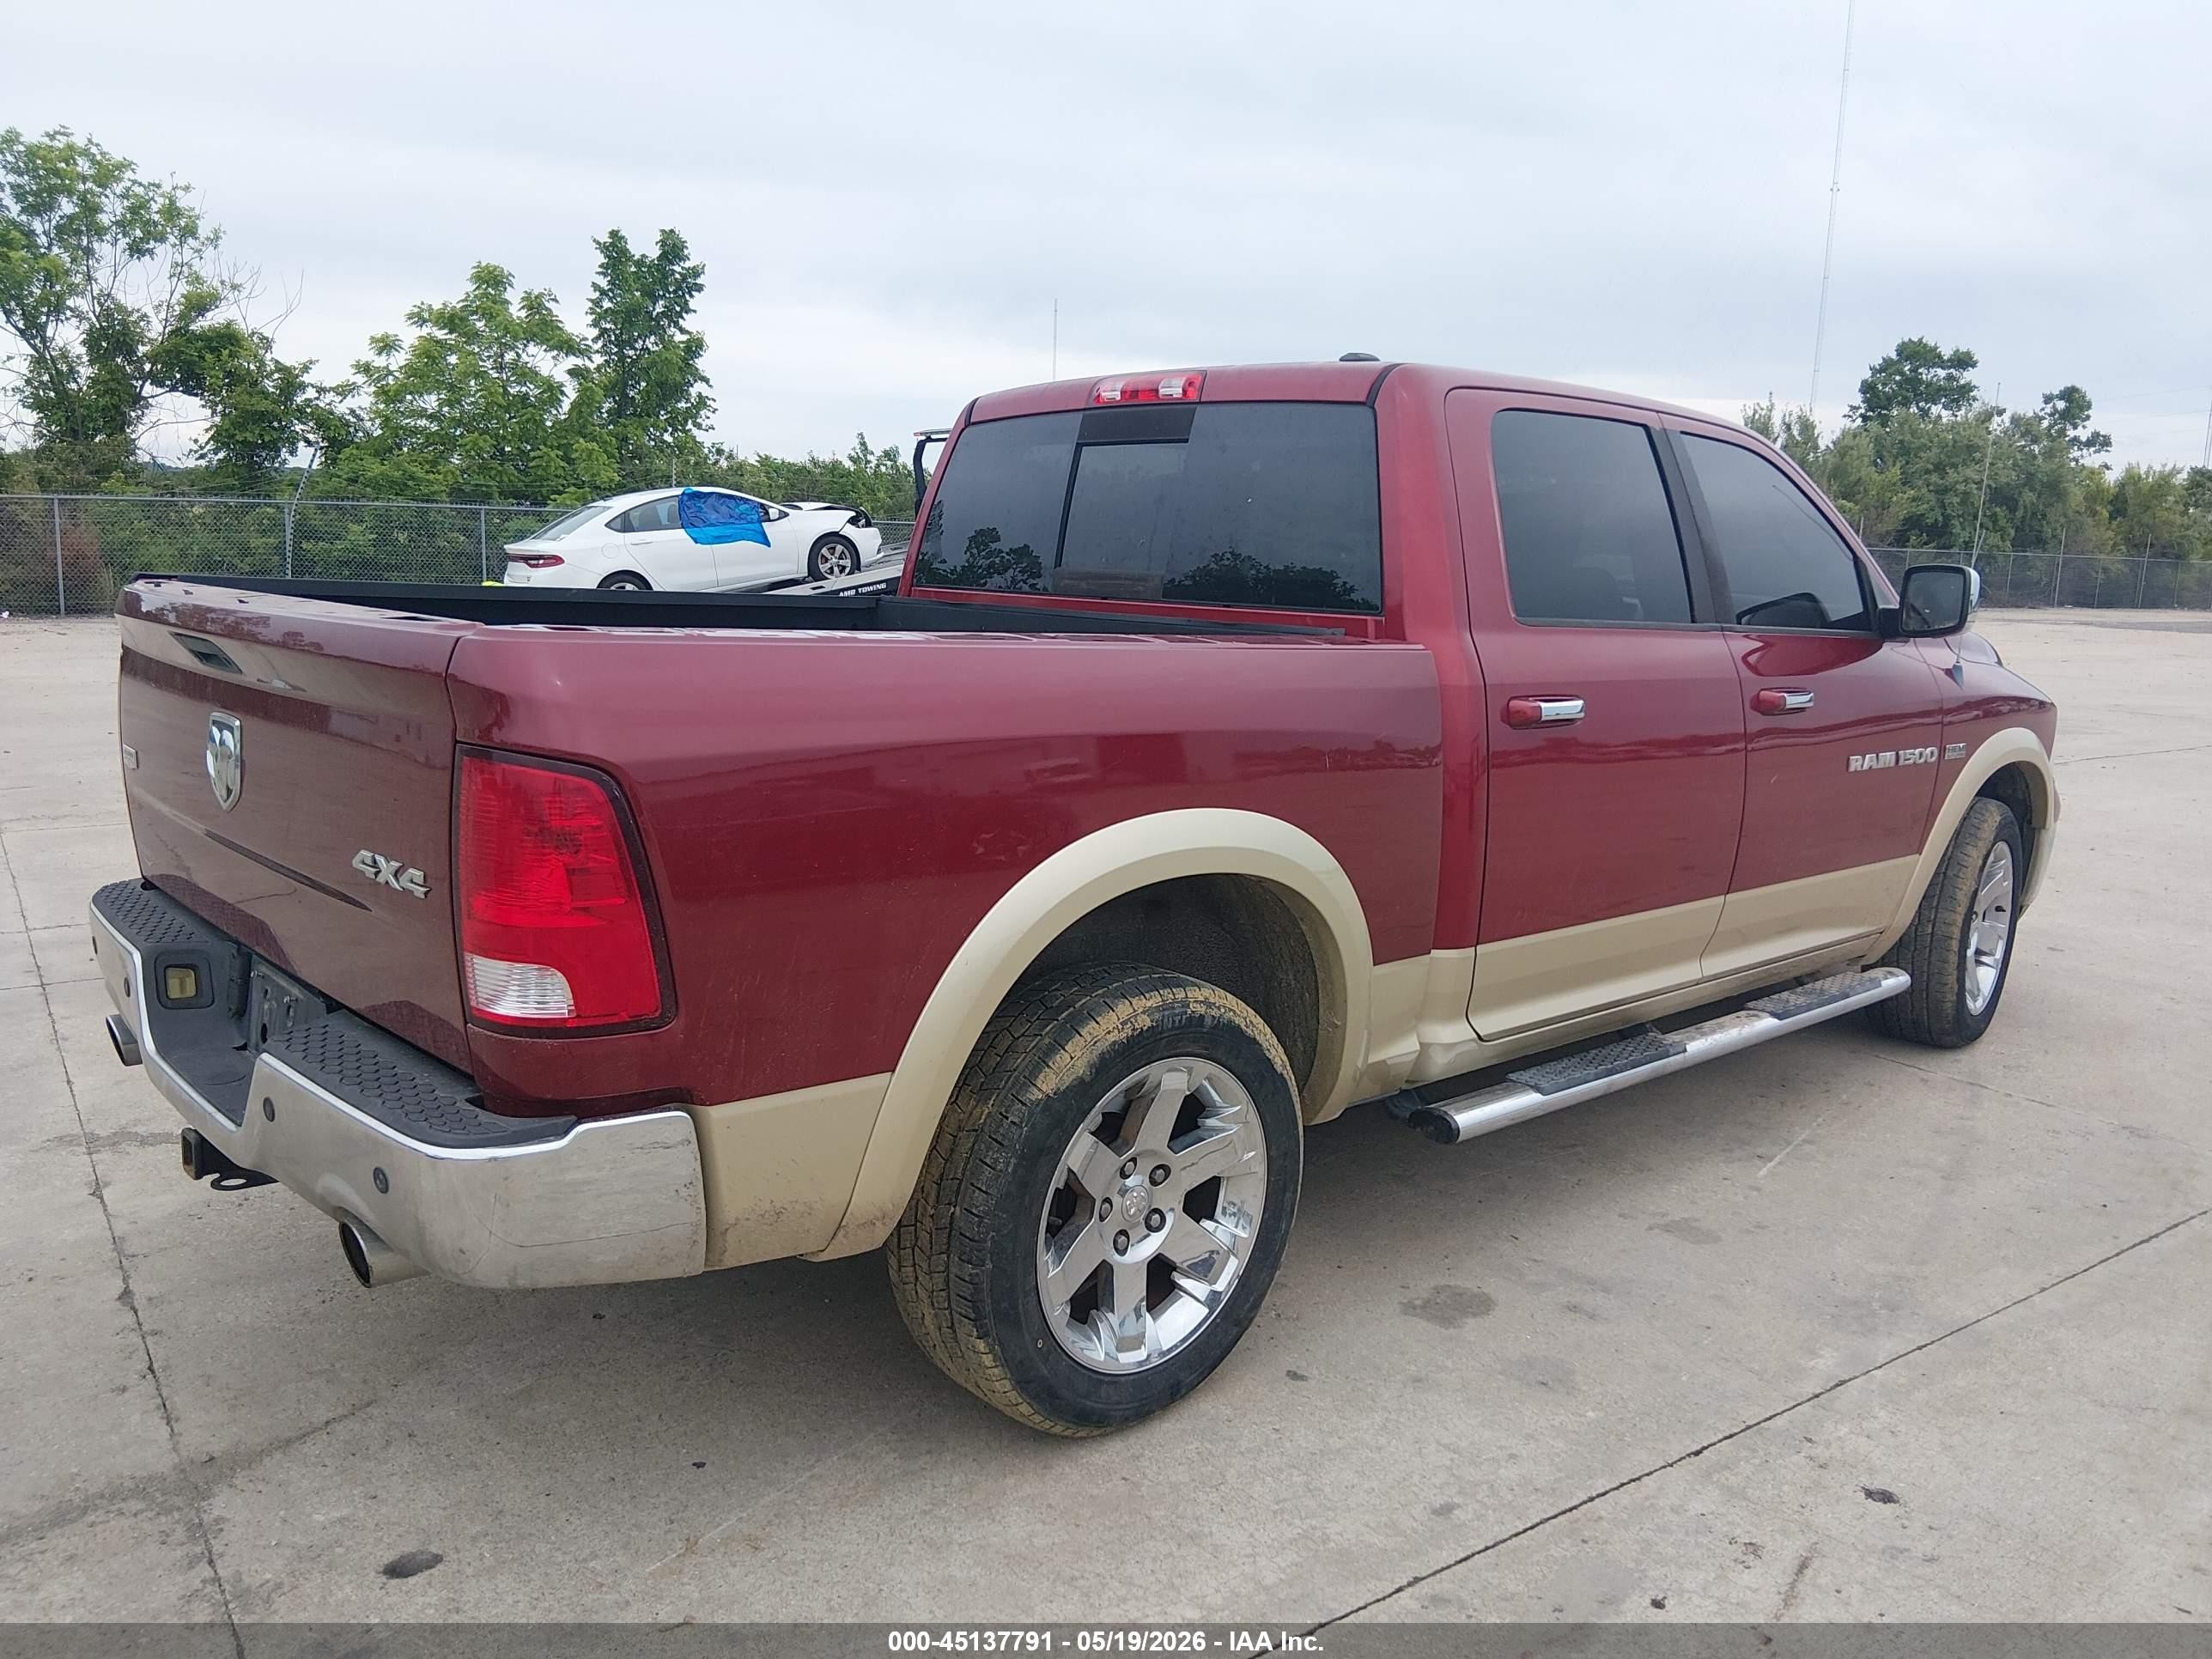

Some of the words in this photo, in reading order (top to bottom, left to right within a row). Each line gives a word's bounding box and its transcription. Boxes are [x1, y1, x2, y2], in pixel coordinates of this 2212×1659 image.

[858, 583, 886, 593] TOWING
[1847, 751, 1896, 772] RAM
[1898, 746, 1938, 766] 1500
